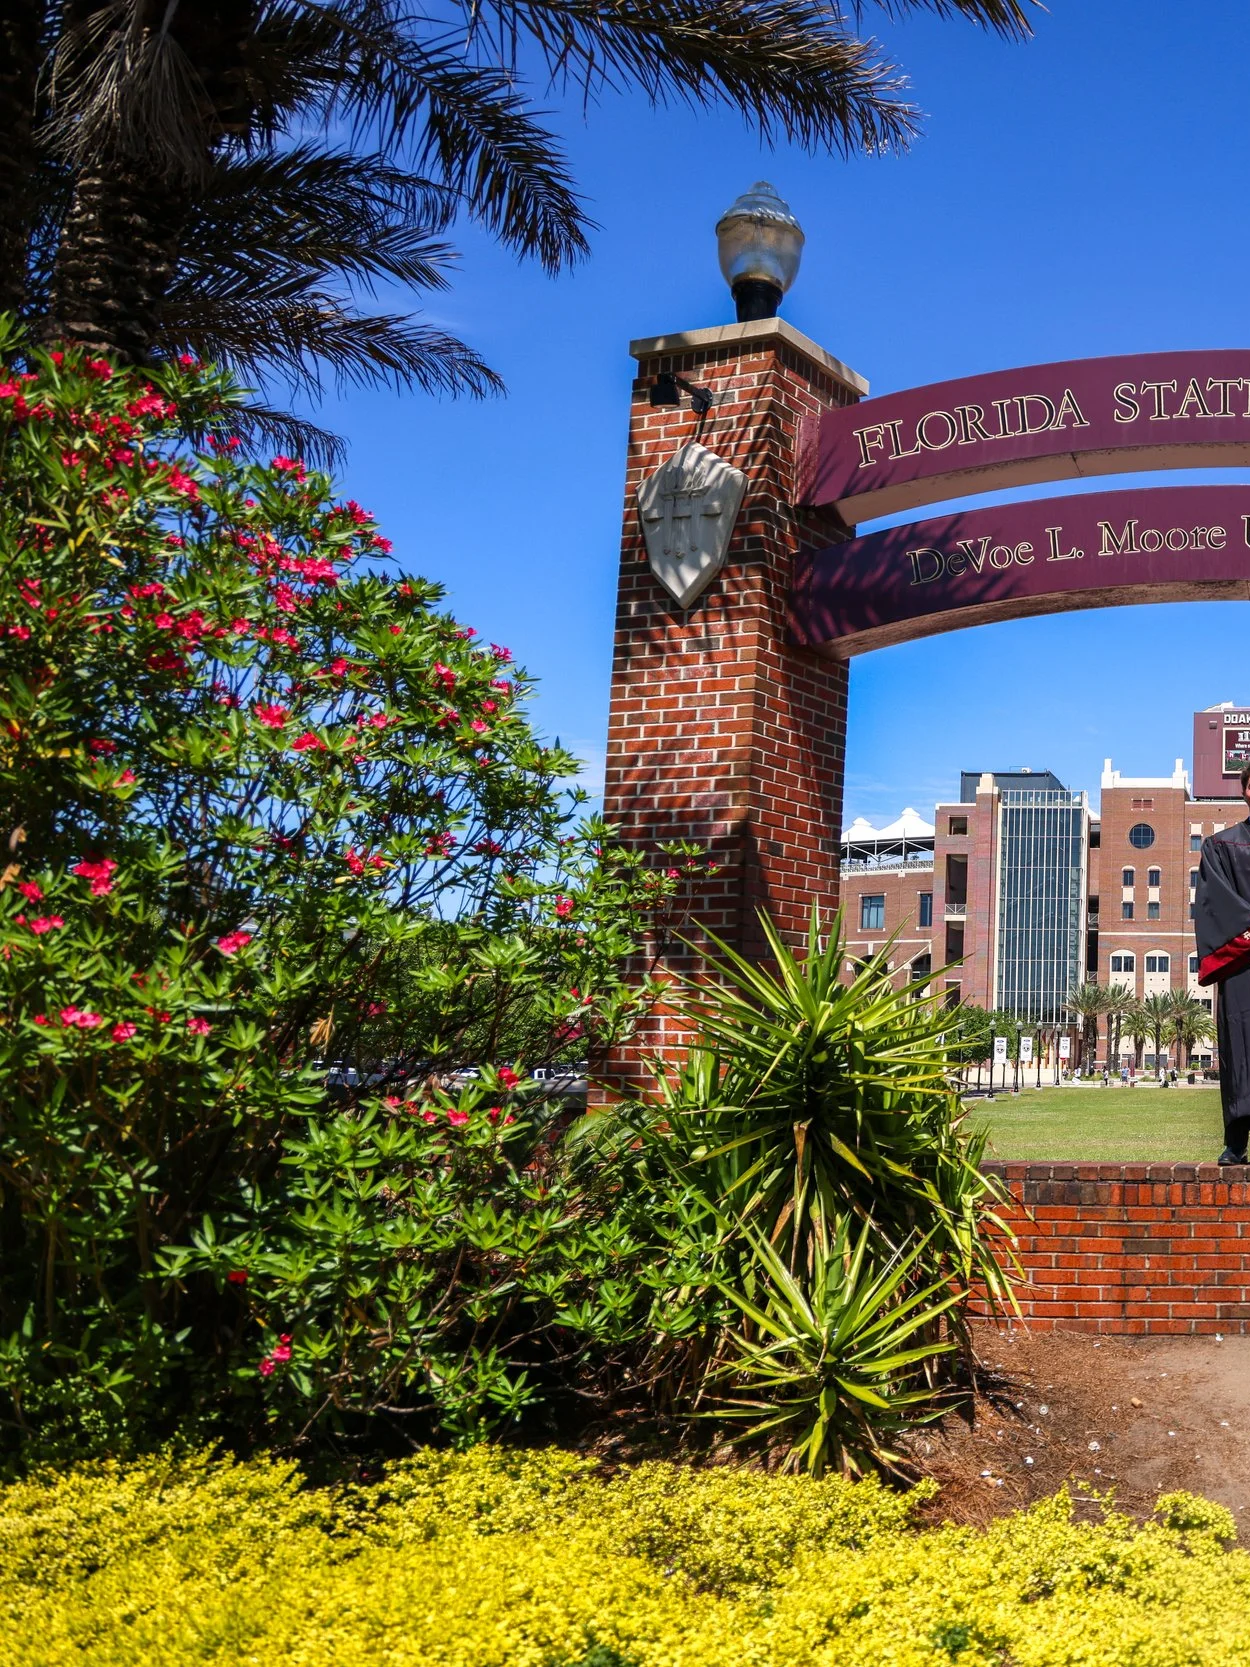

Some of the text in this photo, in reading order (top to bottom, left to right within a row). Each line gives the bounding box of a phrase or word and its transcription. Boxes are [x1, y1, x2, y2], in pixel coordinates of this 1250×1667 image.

[852, 388, 1090, 469] FLORIDA
[905, 536, 1036, 586] DeVoe
[1044, 527, 1085, 562] L.
[1097, 519, 1227, 557] Moore
